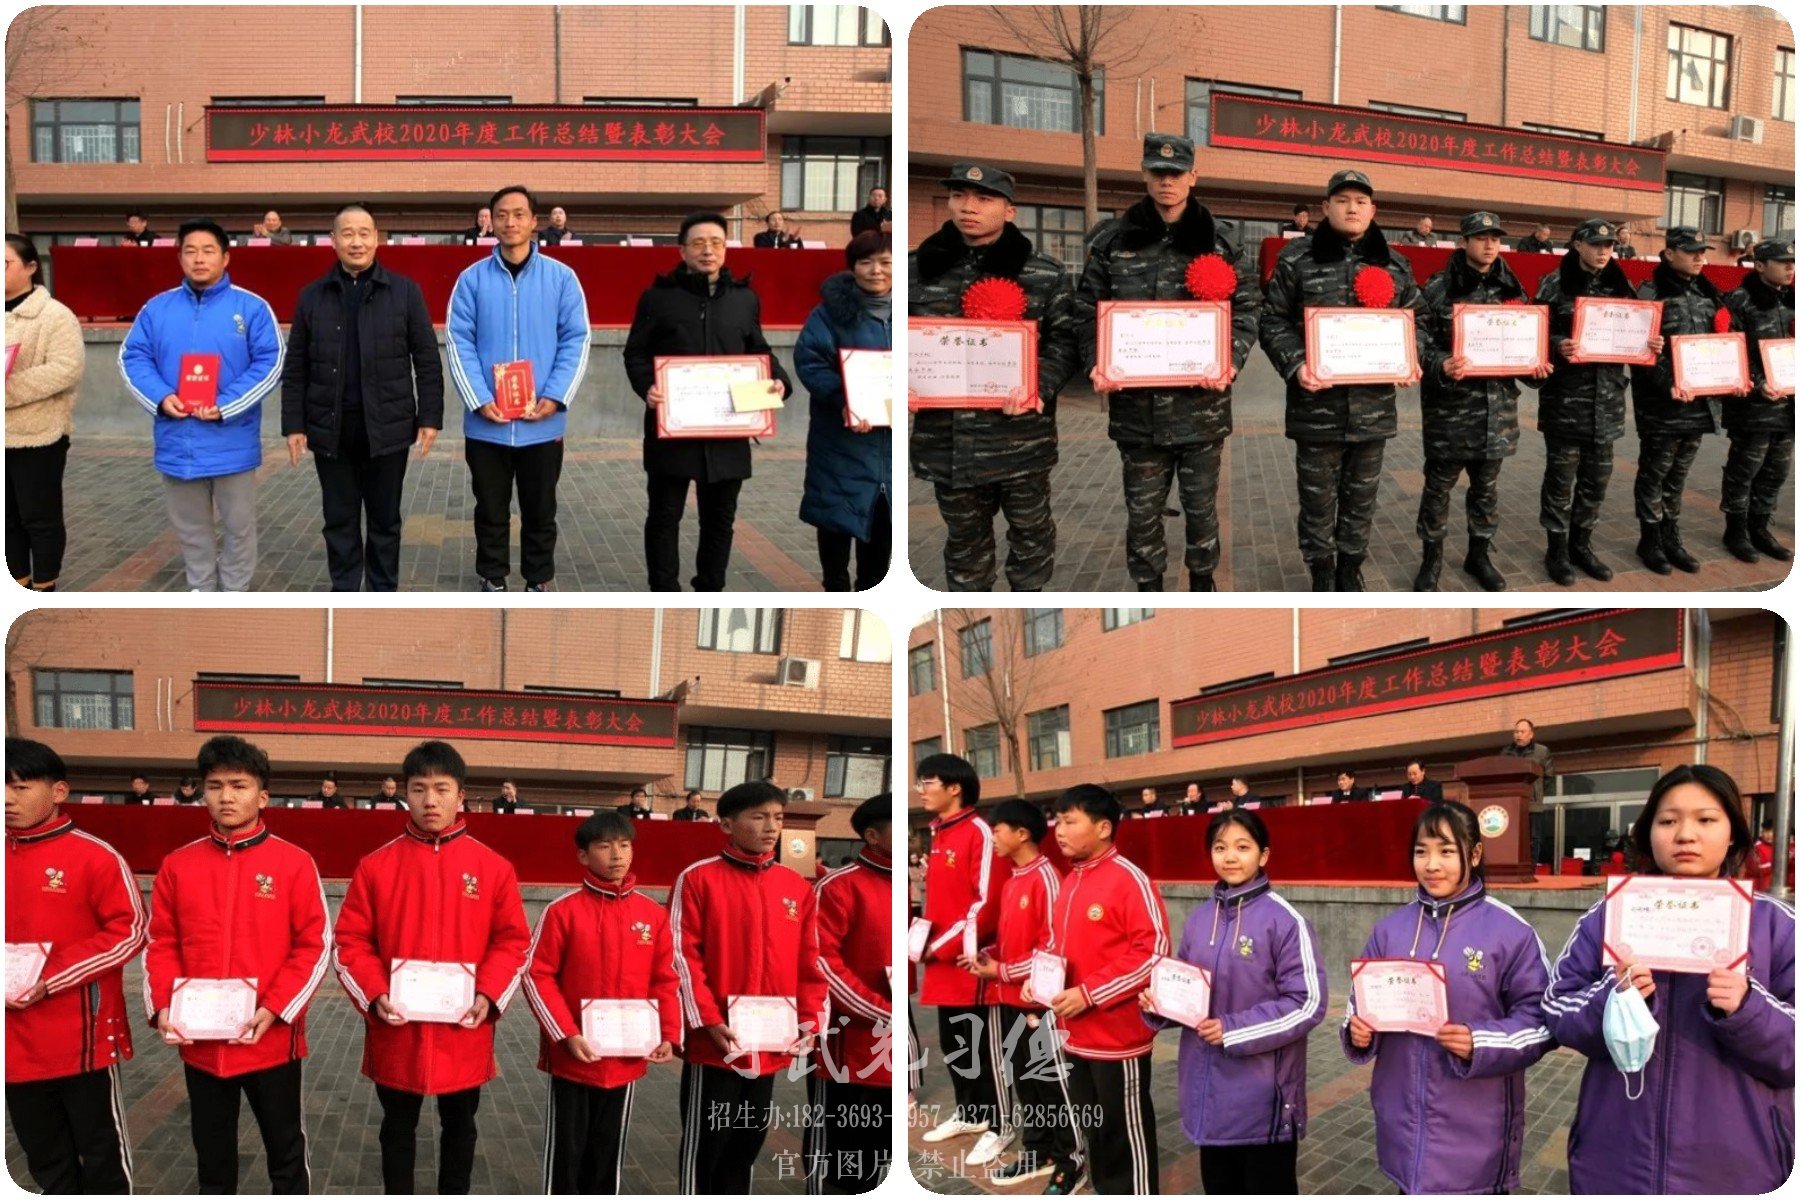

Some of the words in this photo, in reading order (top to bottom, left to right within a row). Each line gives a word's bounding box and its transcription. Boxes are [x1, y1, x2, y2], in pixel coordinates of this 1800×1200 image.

[249, 121, 726, 147] 少林小龙武校2020年度工作总结暨表彰大会
[1255, 112, 1640, 177] 少林小龙武校2020年度工作总结暨表彰大会
[939, 334, 989, 347] 荣誉证书
[1196, 627, 1627, 730] 少林小龙武校2020年度工作总结暨表彰大会
[232, 698, 645, 733] 少林小龙武校2020年度工作总结暨表彰大会
[1653, 899, 1700, 911] 荣誉证书
